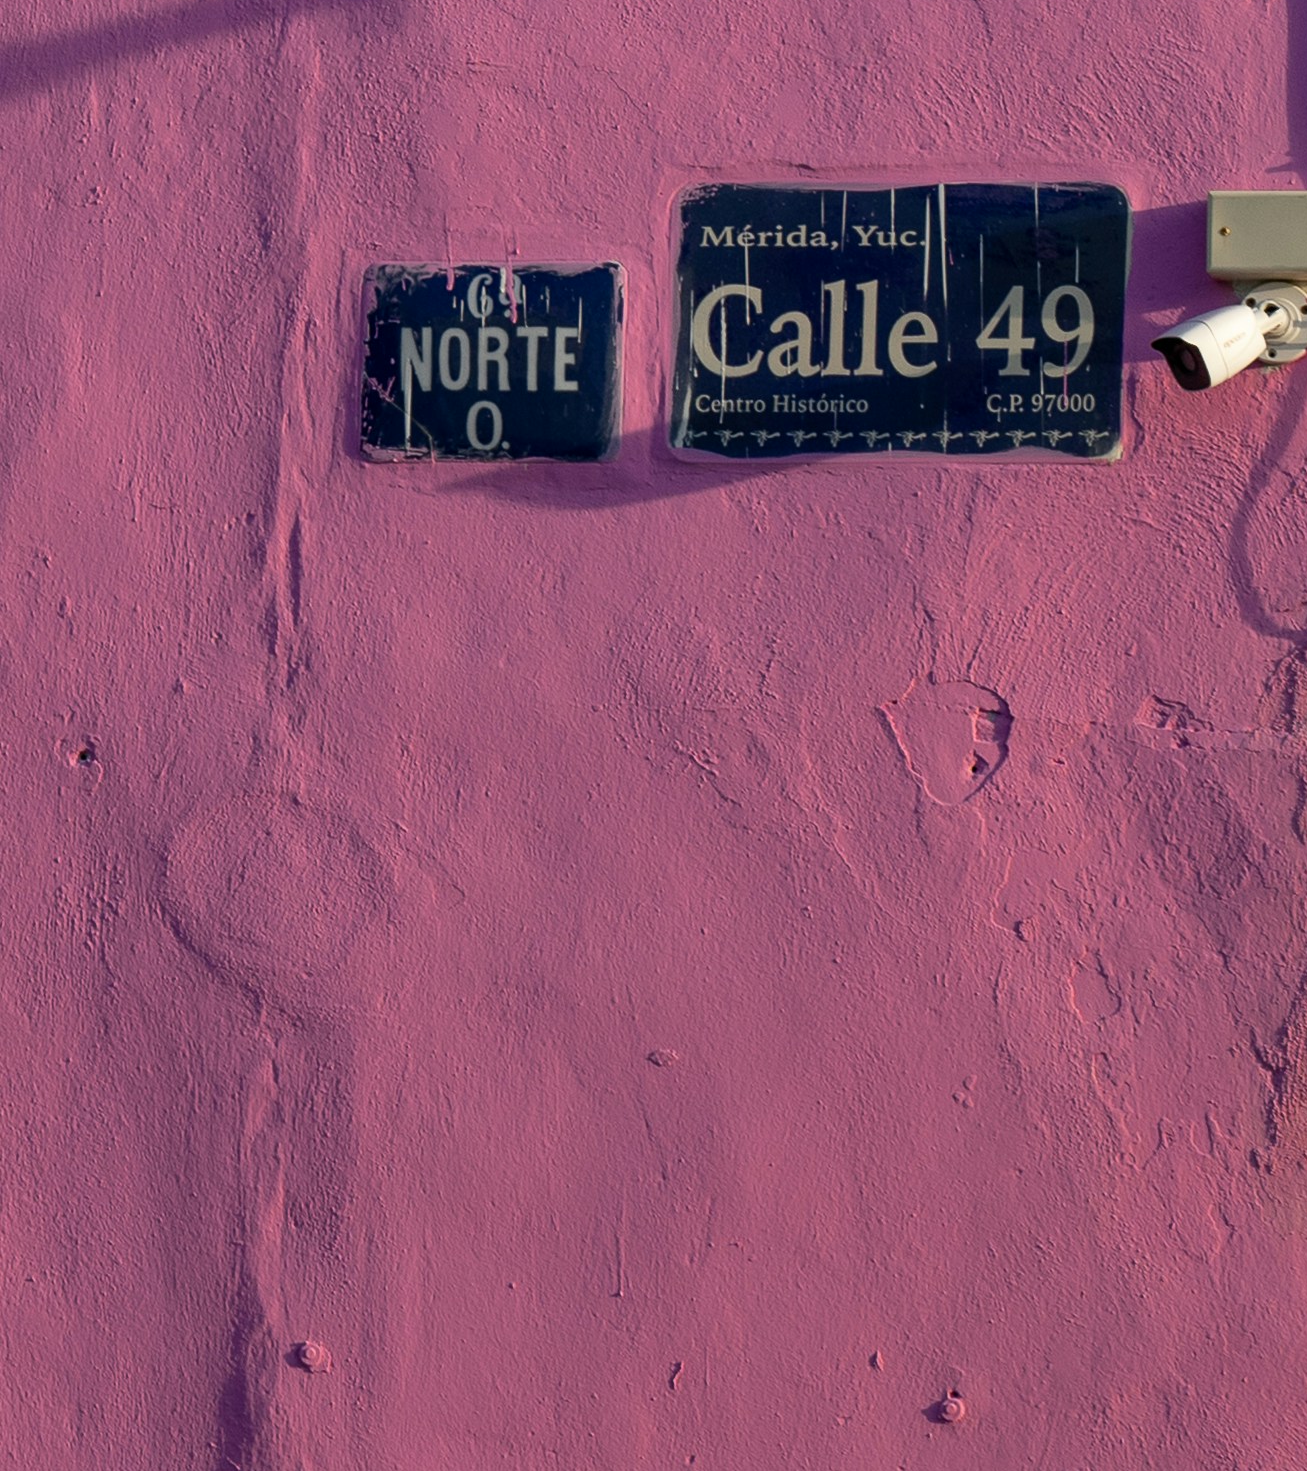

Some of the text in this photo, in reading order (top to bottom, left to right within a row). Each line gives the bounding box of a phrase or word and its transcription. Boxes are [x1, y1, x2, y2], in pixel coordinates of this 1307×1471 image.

[701, 224, 926, 250] Mérida, Yuc.
[693, 280, 1095, 378] Calle 49
[401, 327, 579, 392] NORTE
[695, 393, 869, 413] Centro Histórico
[986, 394, 1096, 413] C.P. 97000
